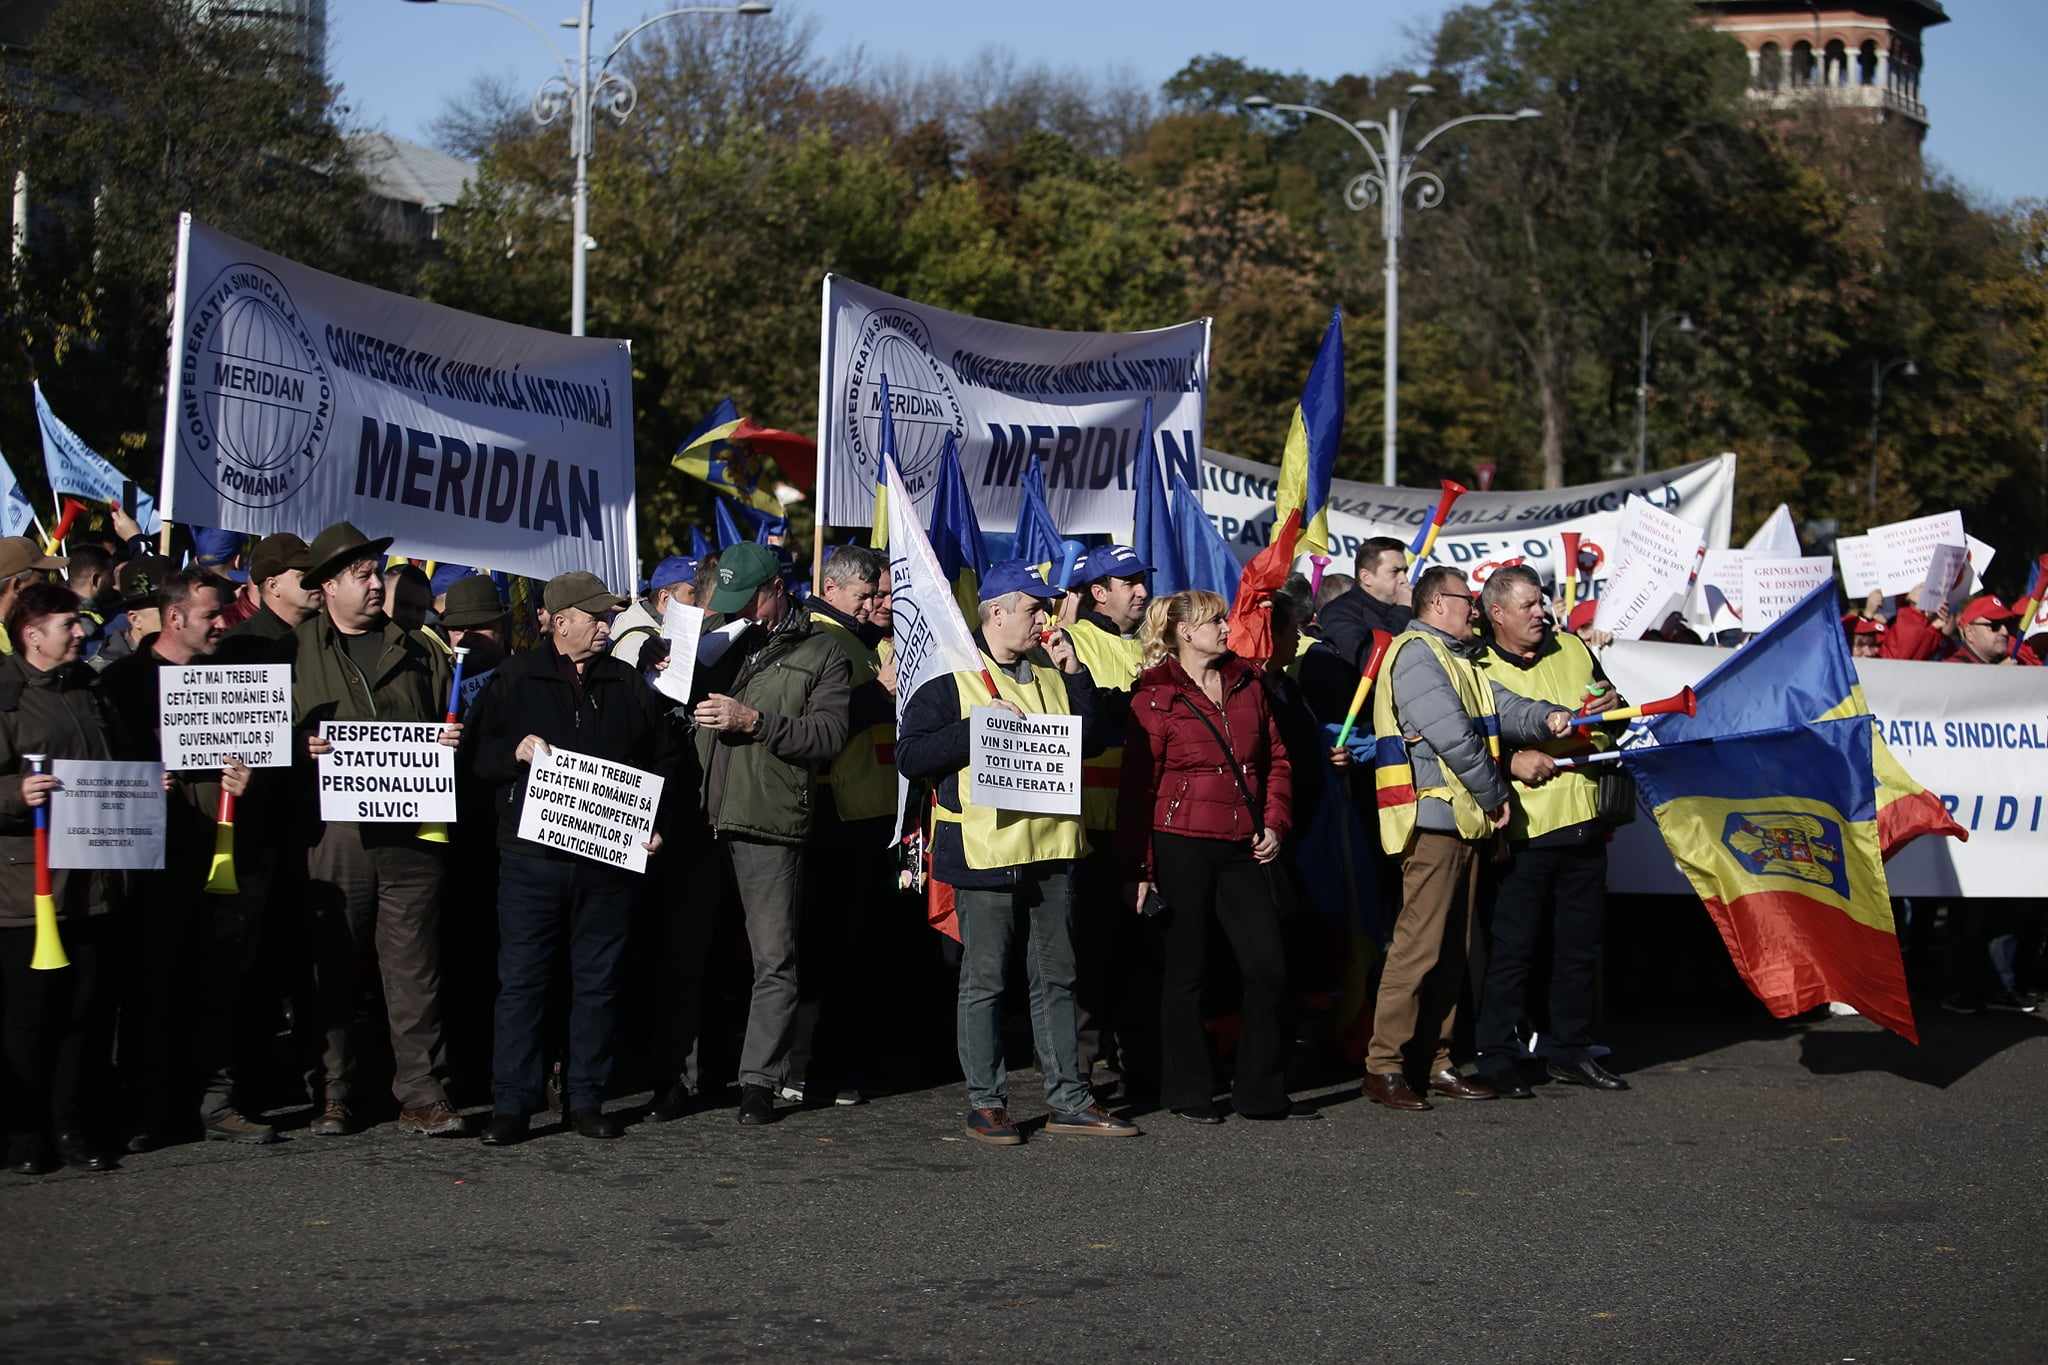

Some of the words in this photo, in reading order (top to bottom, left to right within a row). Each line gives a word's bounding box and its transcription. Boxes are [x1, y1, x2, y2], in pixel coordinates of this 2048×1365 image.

[214, 362, 304, 403] MERIDIAN
[982, 423, 1199, 491] MERIDIN
[221, 464, 288, 496] ROMÂNIA
[354, 415, 603, 542] MERIDIAN
[1331, 495, 1512, 526] NAȚIOALĂ
[205, 671, 223, 684] MAI
[226, 670, 268, 683] TREBUIE
[221, 688, 270, 704] ROMÂNIEI
[272, 687, 285, 703] SĂ
[163, 712, 209, 726] SUPORTE
[986, 717, 1069, 736] GUVERNANTII
[981, 735, 1000, 748] VIN
[1002, 738, 1013, 750] SI
[1016, 741, 1070, 757] PLEACA,
[1876, 719, 1937, 757] RAȚIA
[1944, 722, 2048, 749] SINDICAL
[182, 753, 188, 766] A
[191, 751, 273, 766] POLITICENILOR?
[333, 750, 440, 768] STATUTULUI
[986, 755, 1010, 768] TOTI
[1014, 759, 1042, 772] UITA
[1046, 762, 1064, 773] DE
[556, 754, 577, 769] CÂT
[579, 760, 598, 775] MAI
[602, 765, 642, 788] TREBUIE
[322, 775, 453, 793] PERSONALULUI
[977, 773, 1013, 788] CALEA
[1016, 778, 1065, 792] FERATA
[529, 785, 576, 809] SUPORTE
[592, 783, 638, 808] ROMÂNIEI
[639, 797, 652, 813] SĂ
[358, 801, 419, 818] SILVIC!
[538, 828, 545, 841] A
[548, 830, 628, 865] POLITICIENILOR?
